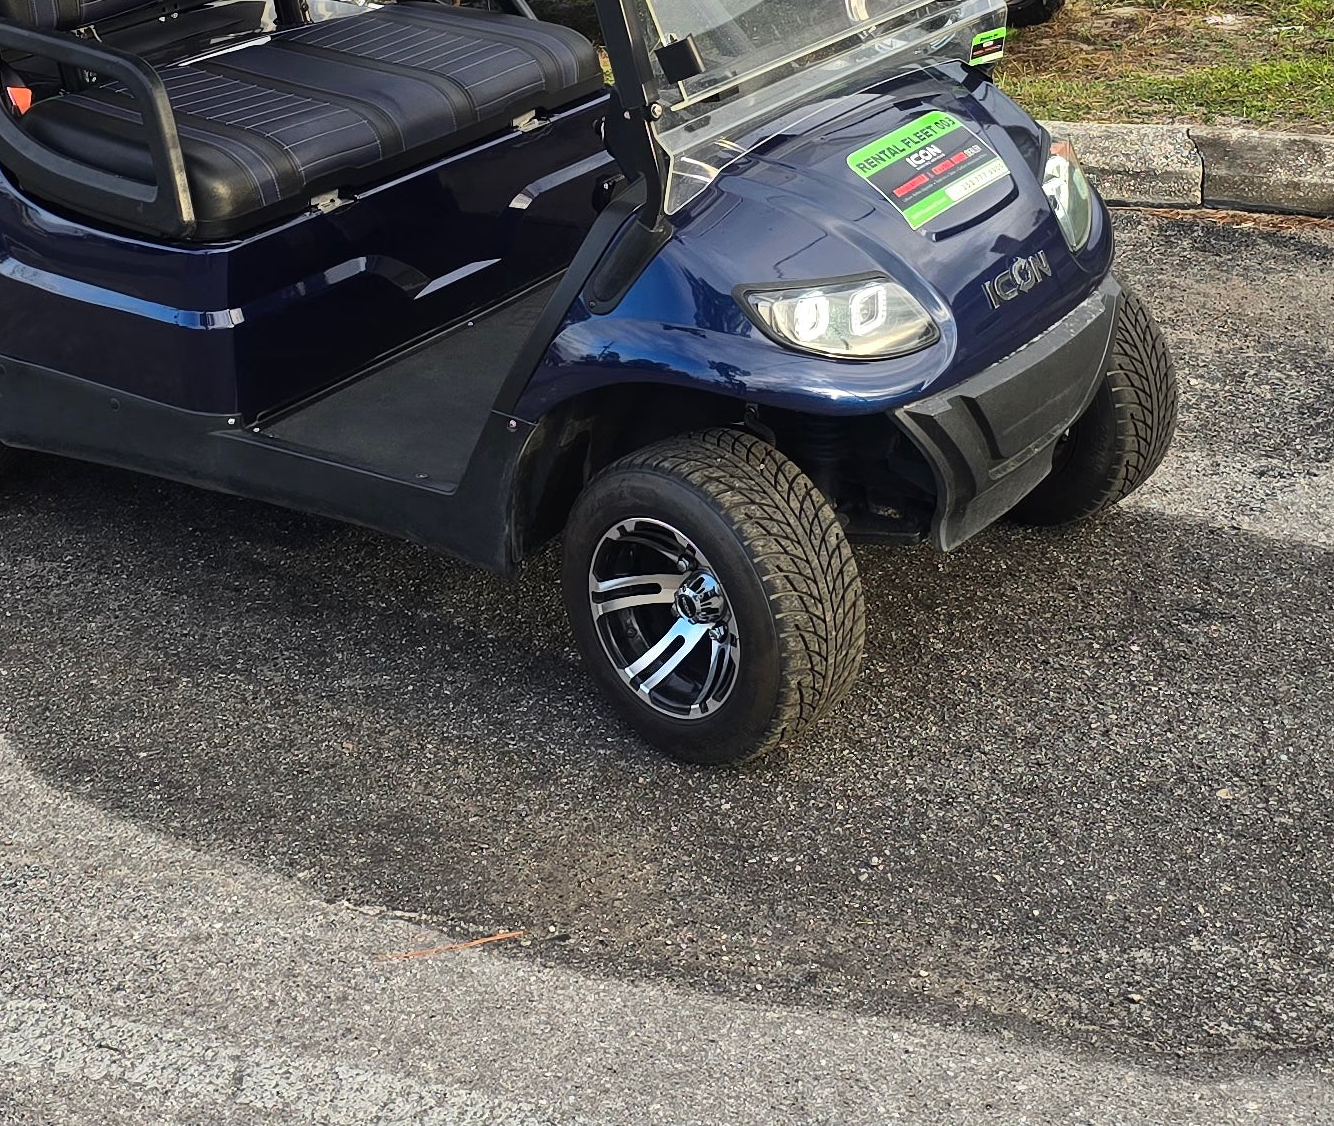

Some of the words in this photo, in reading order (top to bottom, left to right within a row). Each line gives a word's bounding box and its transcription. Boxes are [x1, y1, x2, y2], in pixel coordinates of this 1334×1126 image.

[855, 144, 906, 173] RENTAL
[900, 126, 938, 149] FLEET
[981, 250, 1052, 310] ICON
